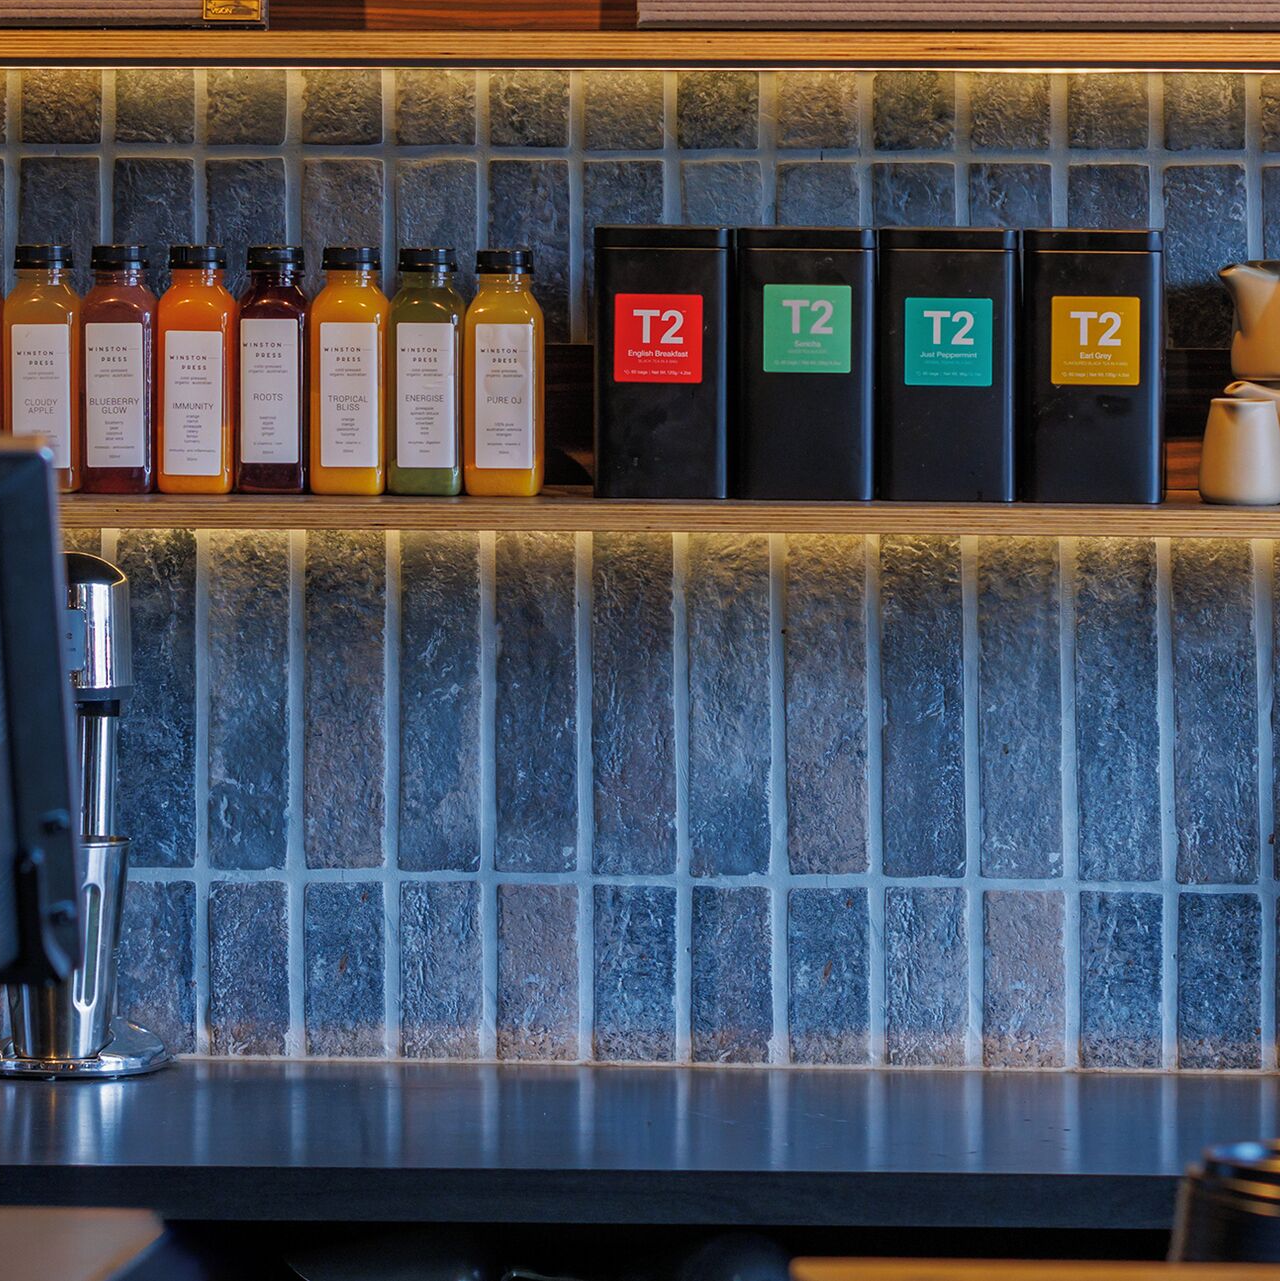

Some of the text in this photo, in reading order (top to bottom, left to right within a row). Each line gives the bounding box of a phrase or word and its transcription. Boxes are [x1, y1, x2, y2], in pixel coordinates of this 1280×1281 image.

[782, 299, 833, 334] T2
[633, 309, 684, 344] T2
[923, 310, 974, 345] T2
[1070, 311, 1122, 346] T2
[628, 349, 688, 358] English Breakfast
[936, 351, 977, 360] Peppermint
[1094, 352, 1112, 360] Grey
[253, 393, 283, 401] ROOTS
[328, 395, 368, 403] TROPICAL
[405, 394, 444, 402] ENERGISE
[487, 396, 522, 404] PURE OJ
[24, 399, 58, 407] CLOUDY
[89, 397, 139, 406] BLUEBERRY
[101, 406, 128, 414] GLOW
[172, 402, 214, 410] IMMUNITY
[336, 403, 360, 411] BLISS
